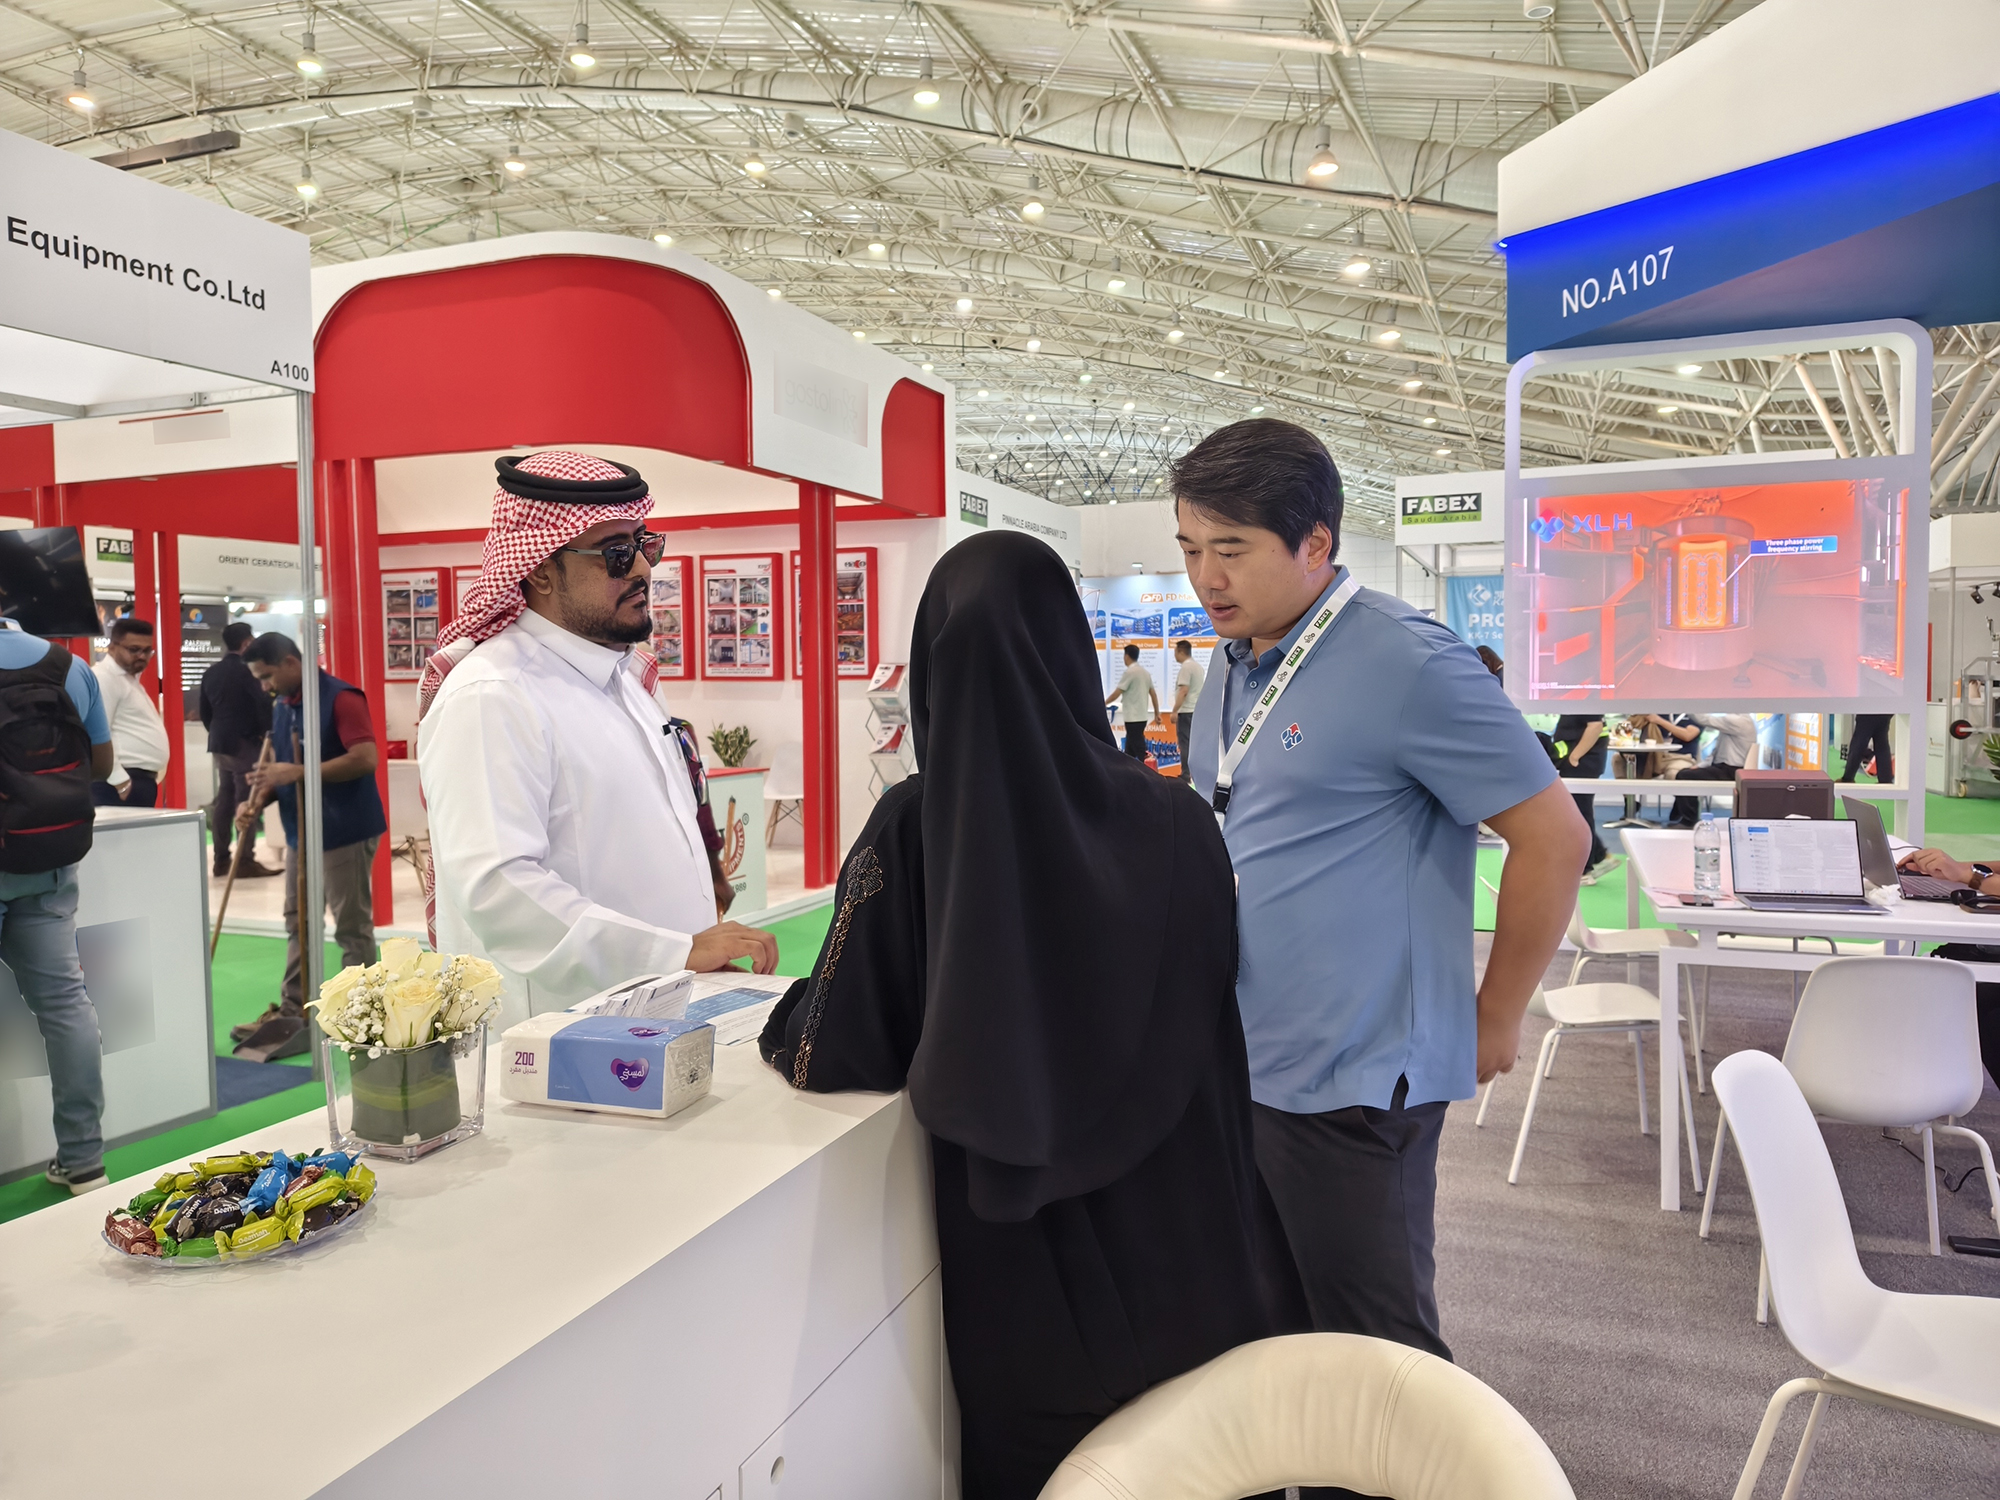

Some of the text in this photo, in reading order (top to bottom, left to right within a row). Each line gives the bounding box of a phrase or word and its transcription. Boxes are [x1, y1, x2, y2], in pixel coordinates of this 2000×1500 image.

[7, 215, 266, 311] Equipment Co.Ltd
[1562, 245, 1675, 318] NO.A107
[270, 360, 309, 382] A100
[961, 493, 987, 516] FABEX
[1406, 495, 1478, 514] FABEX
[1002, 513, 1024, 530] PINNACLE
[1024, 520, 1040, 533] ARABIA
[1040, 524, 1060, 538] COMPANY
[1060, 530, 1068, 540] LTD
[1407, 513, 1478, 524] Saudi Arabia
[1571, 513, 1633, 533] XLH
[1765, 537, 1824, 547] Three phase power
[1767, 544, 1823, 553] frequency stirring
[219, 555, 249, 565] ORIENT
[251, 558, 295, 569] CERATECH
[1166, 593, 1177, 601] FD
[729, 822, 744, 873] IPMENTS
[515, 1051, 535, 1066] 200
